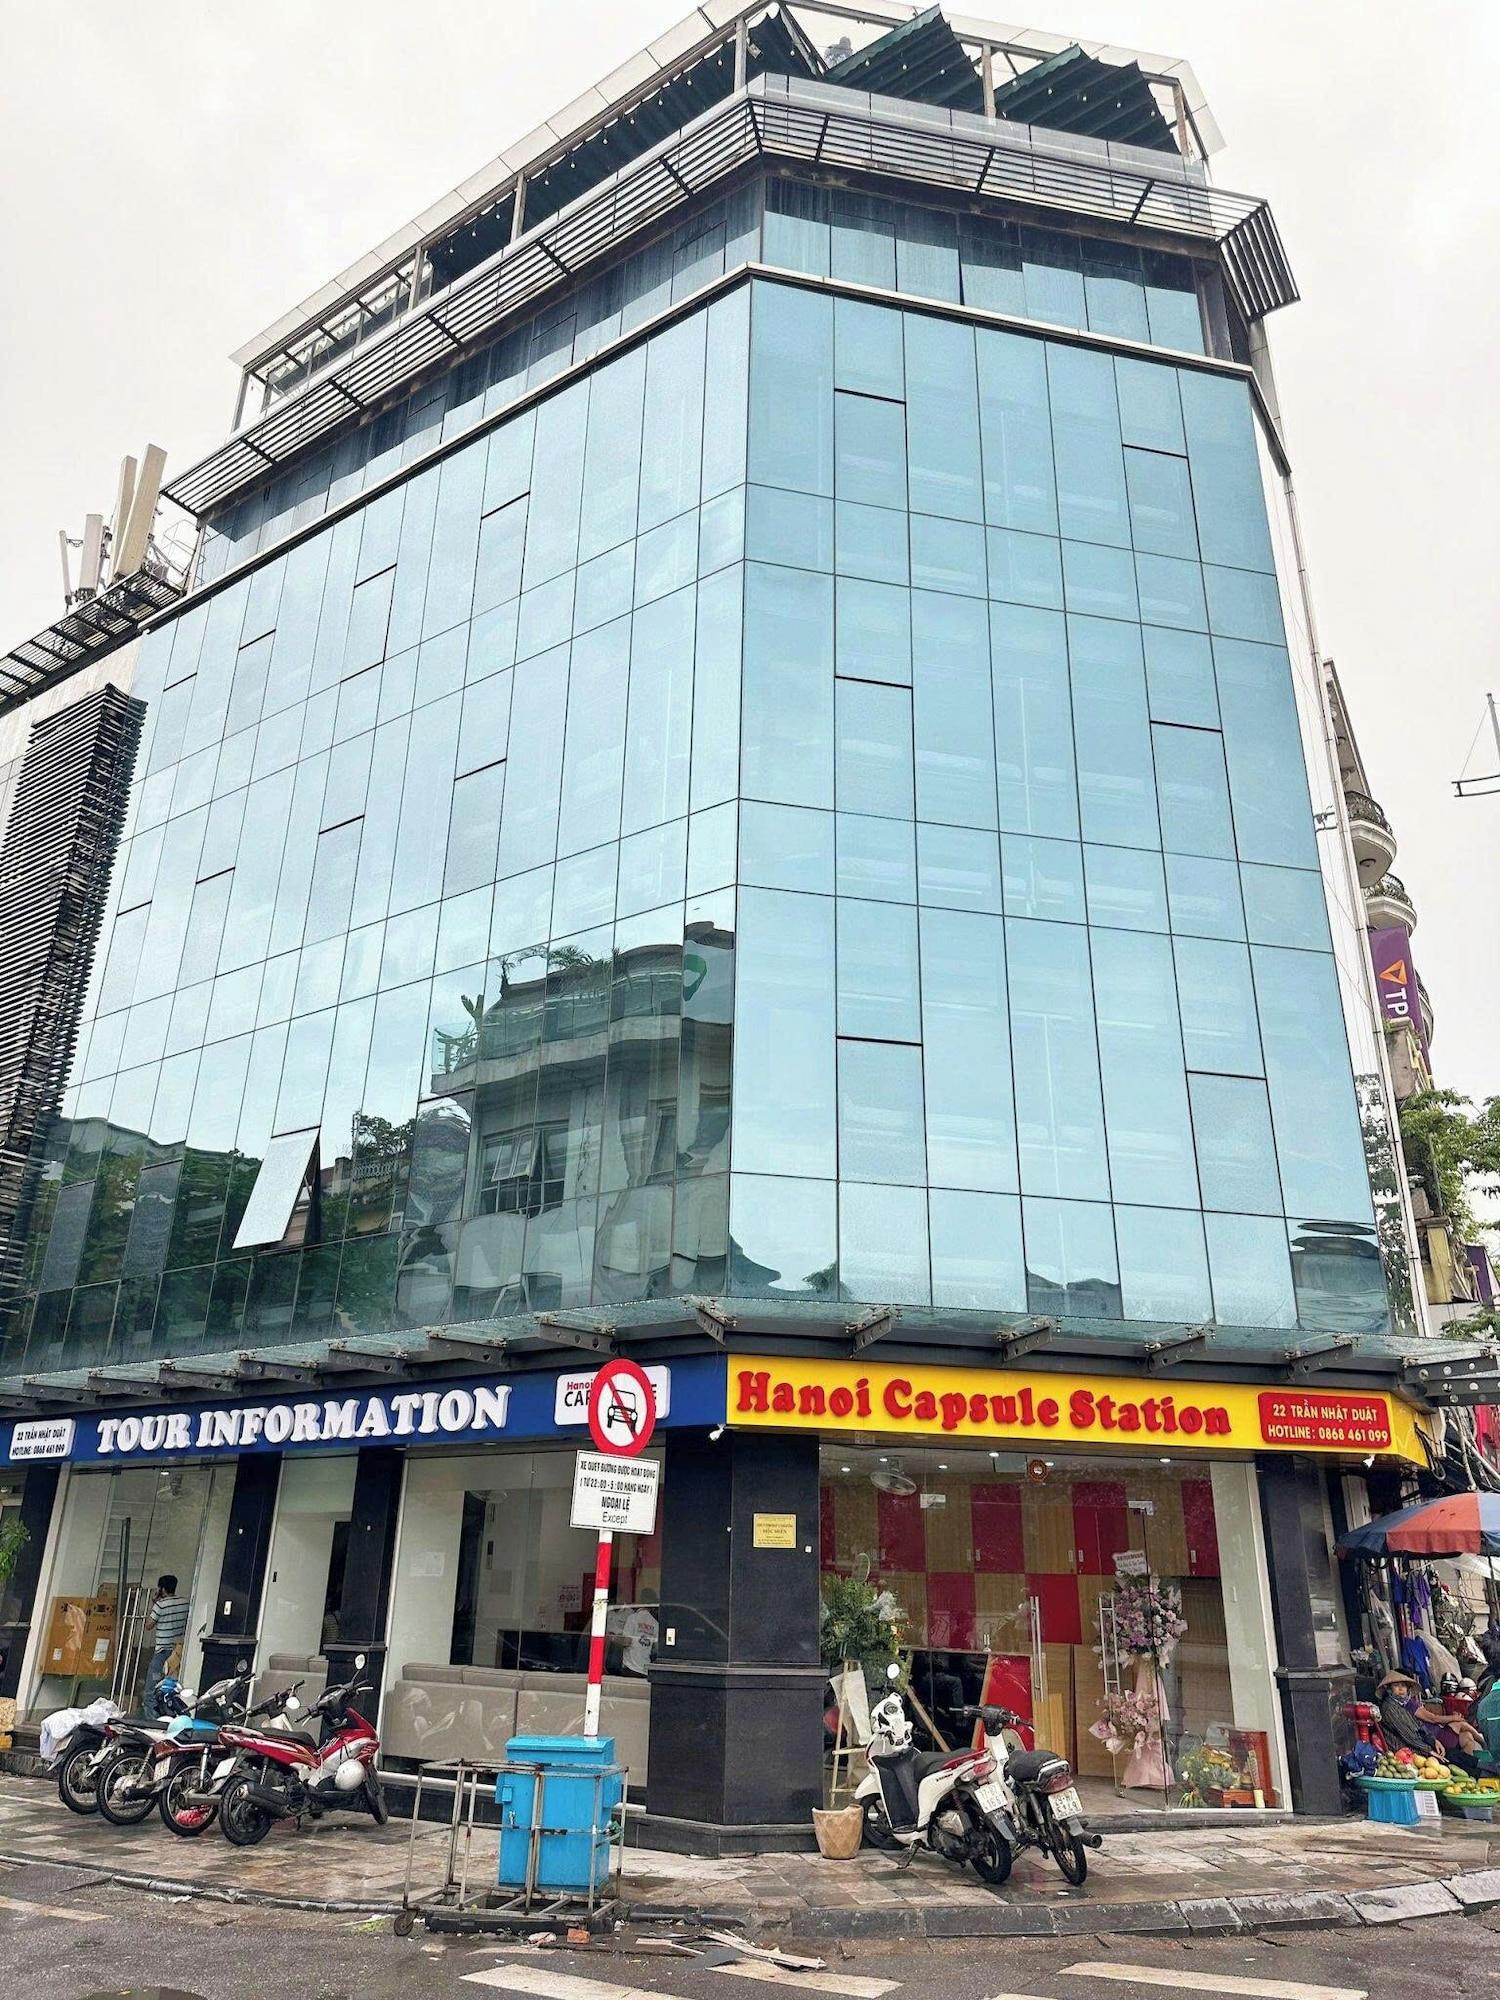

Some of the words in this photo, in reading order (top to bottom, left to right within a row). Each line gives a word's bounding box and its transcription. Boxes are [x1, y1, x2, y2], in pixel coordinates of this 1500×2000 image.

[736, 1370, 871, 1418] Hanoi
[882, 1378, 1060, 1430] Capsule
[1069, 1389, 1234, 1436] Station
[1272, 1403, 1286, 1417] 22
[1290, 1399, 1318, 1419] TRẦN
[1321, 1404, 1349, 1423] NHẬT
[1351, 1406, 1377, 1424] DUẬT
[97, 1412, 193, 1454] TOUR
[196, 1384, 513, 1448] INFORMATION
[17, 1432, 24, 1441] 22
[1267, 1424, 1315, 1440] HOTLINE:
[1318, 1426, 1345, 1441] 0868
[1347, 1428, 1367, 1442] 461
[1368, 1429, 1388, 1443] 099
[602, 1511, 628, 1526] Except
